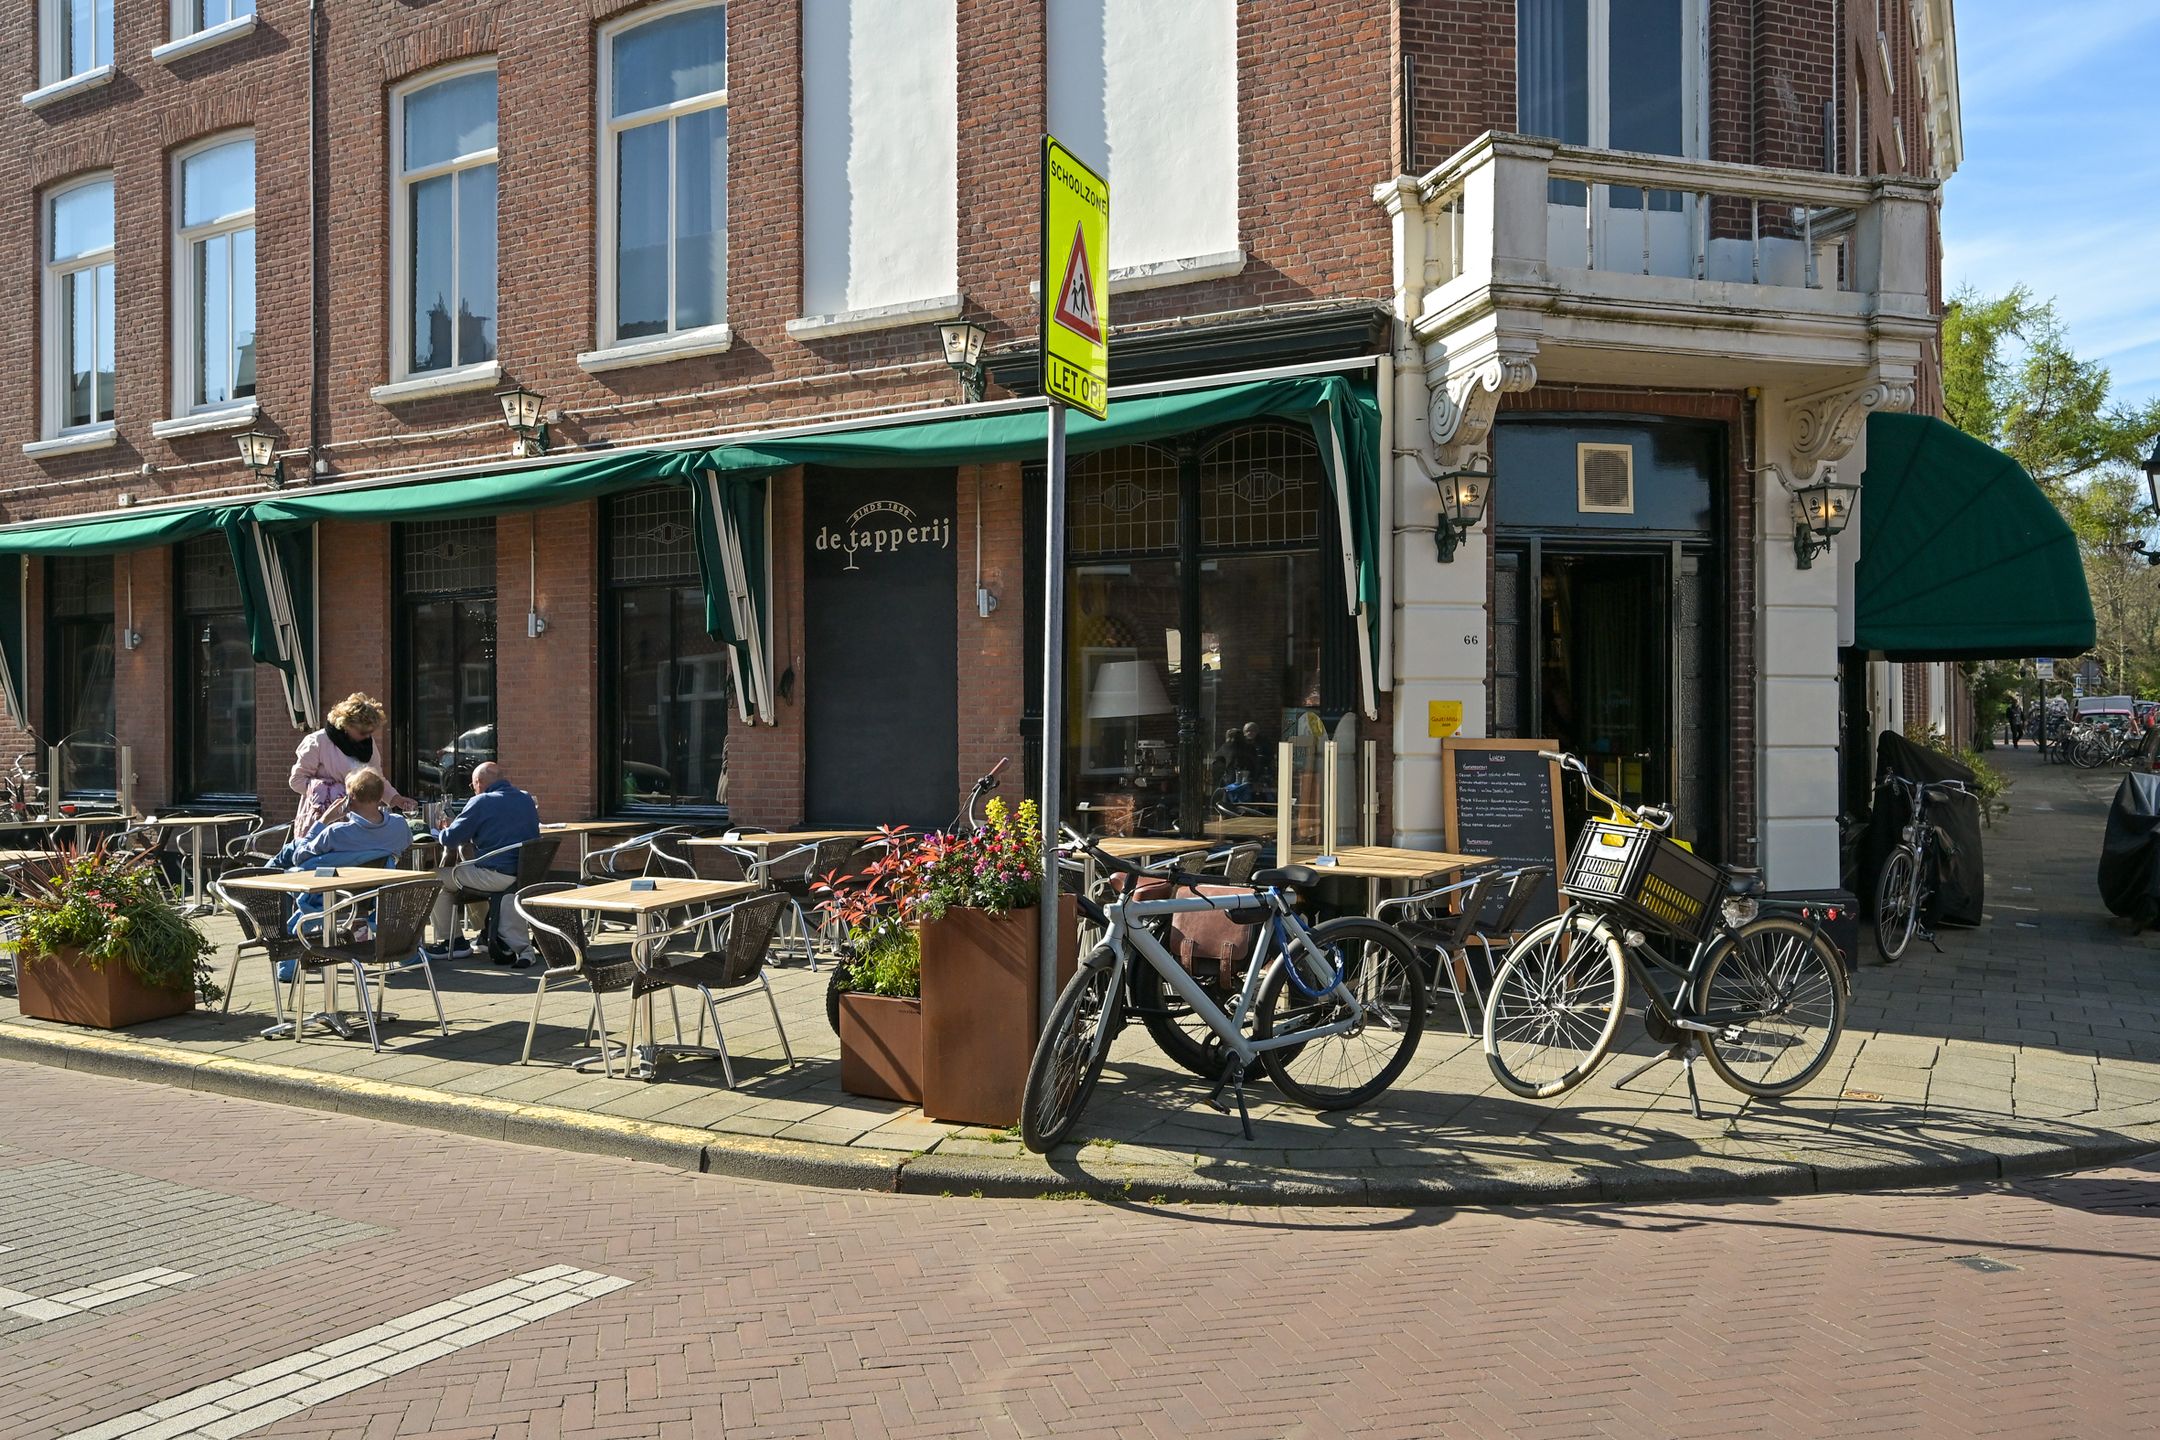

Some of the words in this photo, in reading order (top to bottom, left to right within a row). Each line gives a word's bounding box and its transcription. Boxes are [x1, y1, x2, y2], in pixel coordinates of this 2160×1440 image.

[1051, 160, 1107, 216] SCHOOLZONE
[1053, 361, 1078, 394] LET
[1082, 376, 1104, 408] OP!
[853, 502, 882, 520] SINDS
[816, 526, 841, 550] de
[850, 518, 950, 553] tapperij
[1464, 635, 1479, 645] 66
